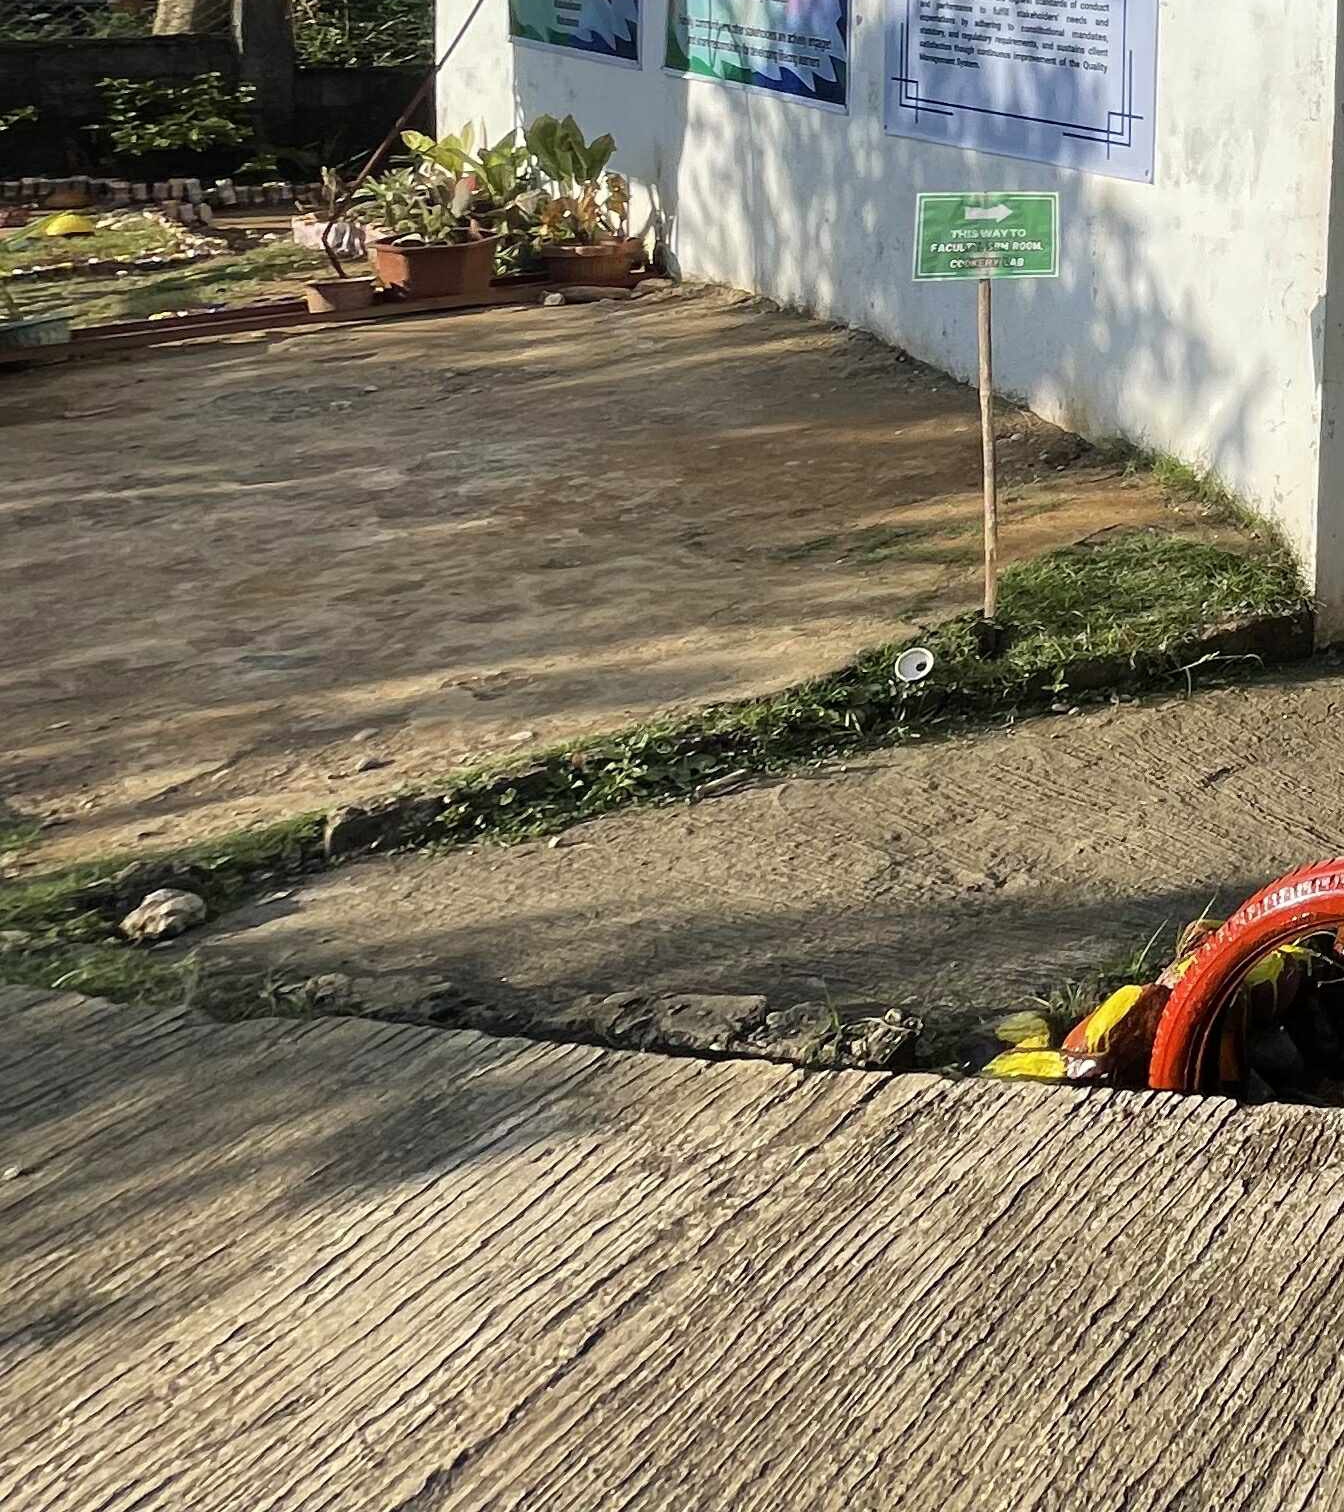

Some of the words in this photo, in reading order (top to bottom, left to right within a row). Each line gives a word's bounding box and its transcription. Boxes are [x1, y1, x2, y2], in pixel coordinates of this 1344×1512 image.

[1070, 0, 1077, 9] of
[1080, 2, 1110, 12] conduct
[1082, 60, 1108, 74] Quality
[951, 229, 978, 238] THIS
[981, 229, 1007, 238] WAY
[1010, 228, 1026, 237] TO
